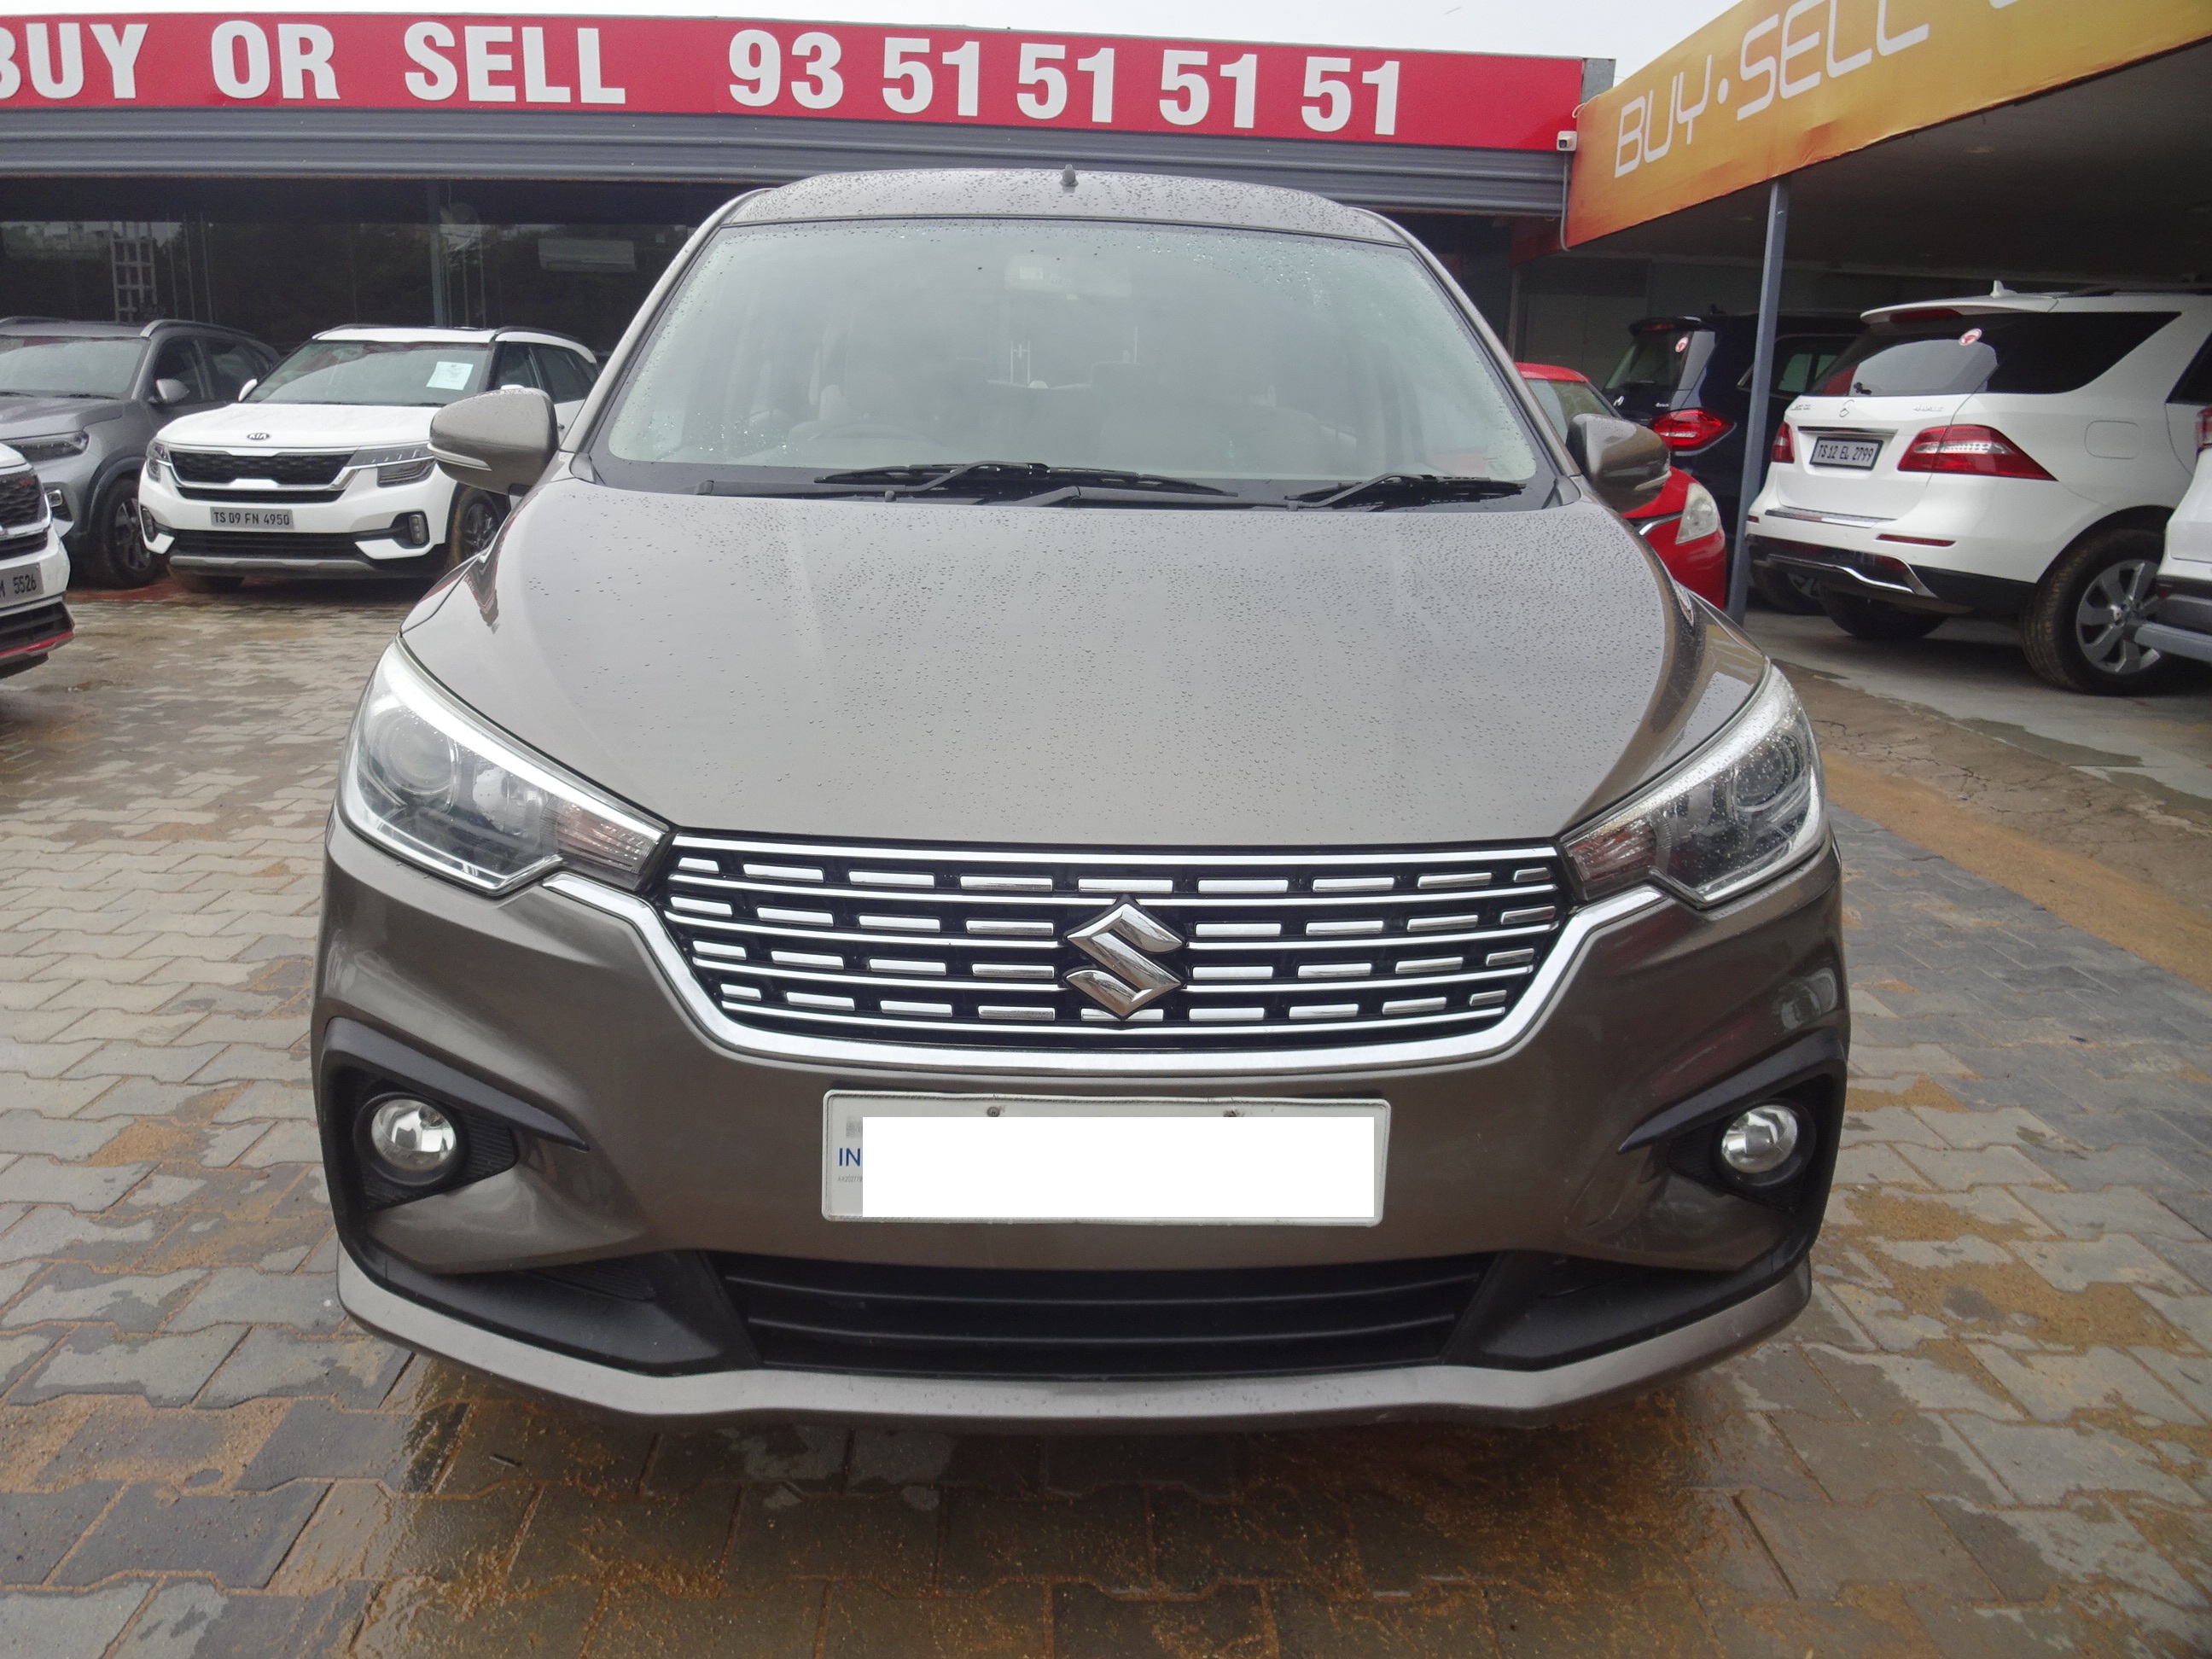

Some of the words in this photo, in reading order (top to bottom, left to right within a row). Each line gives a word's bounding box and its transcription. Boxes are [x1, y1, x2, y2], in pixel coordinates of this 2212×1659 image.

[212, 20, 340, 99] OR
[405, 21, 626, 104] SELL
[729, 29, 843, 109] 93
[882, 38, 979, 116] 51
[1017, 43, 1115, 123] 51
[1160, 49, 1257, 128] 51
[1301, 56, 1400, 135] 51
[1615, 55, 1713, 178] BUY
[1852, 446, 1874, 462] 2799
[213, 512, 226, 523] TS
[229, 512, 241, 524] 09
[245, 513, 259, 524] FN
[264, 514, 290, 526] 4950
[13, 573, 38, 595] 5526
[839, 1148, 861, 1167] IN
